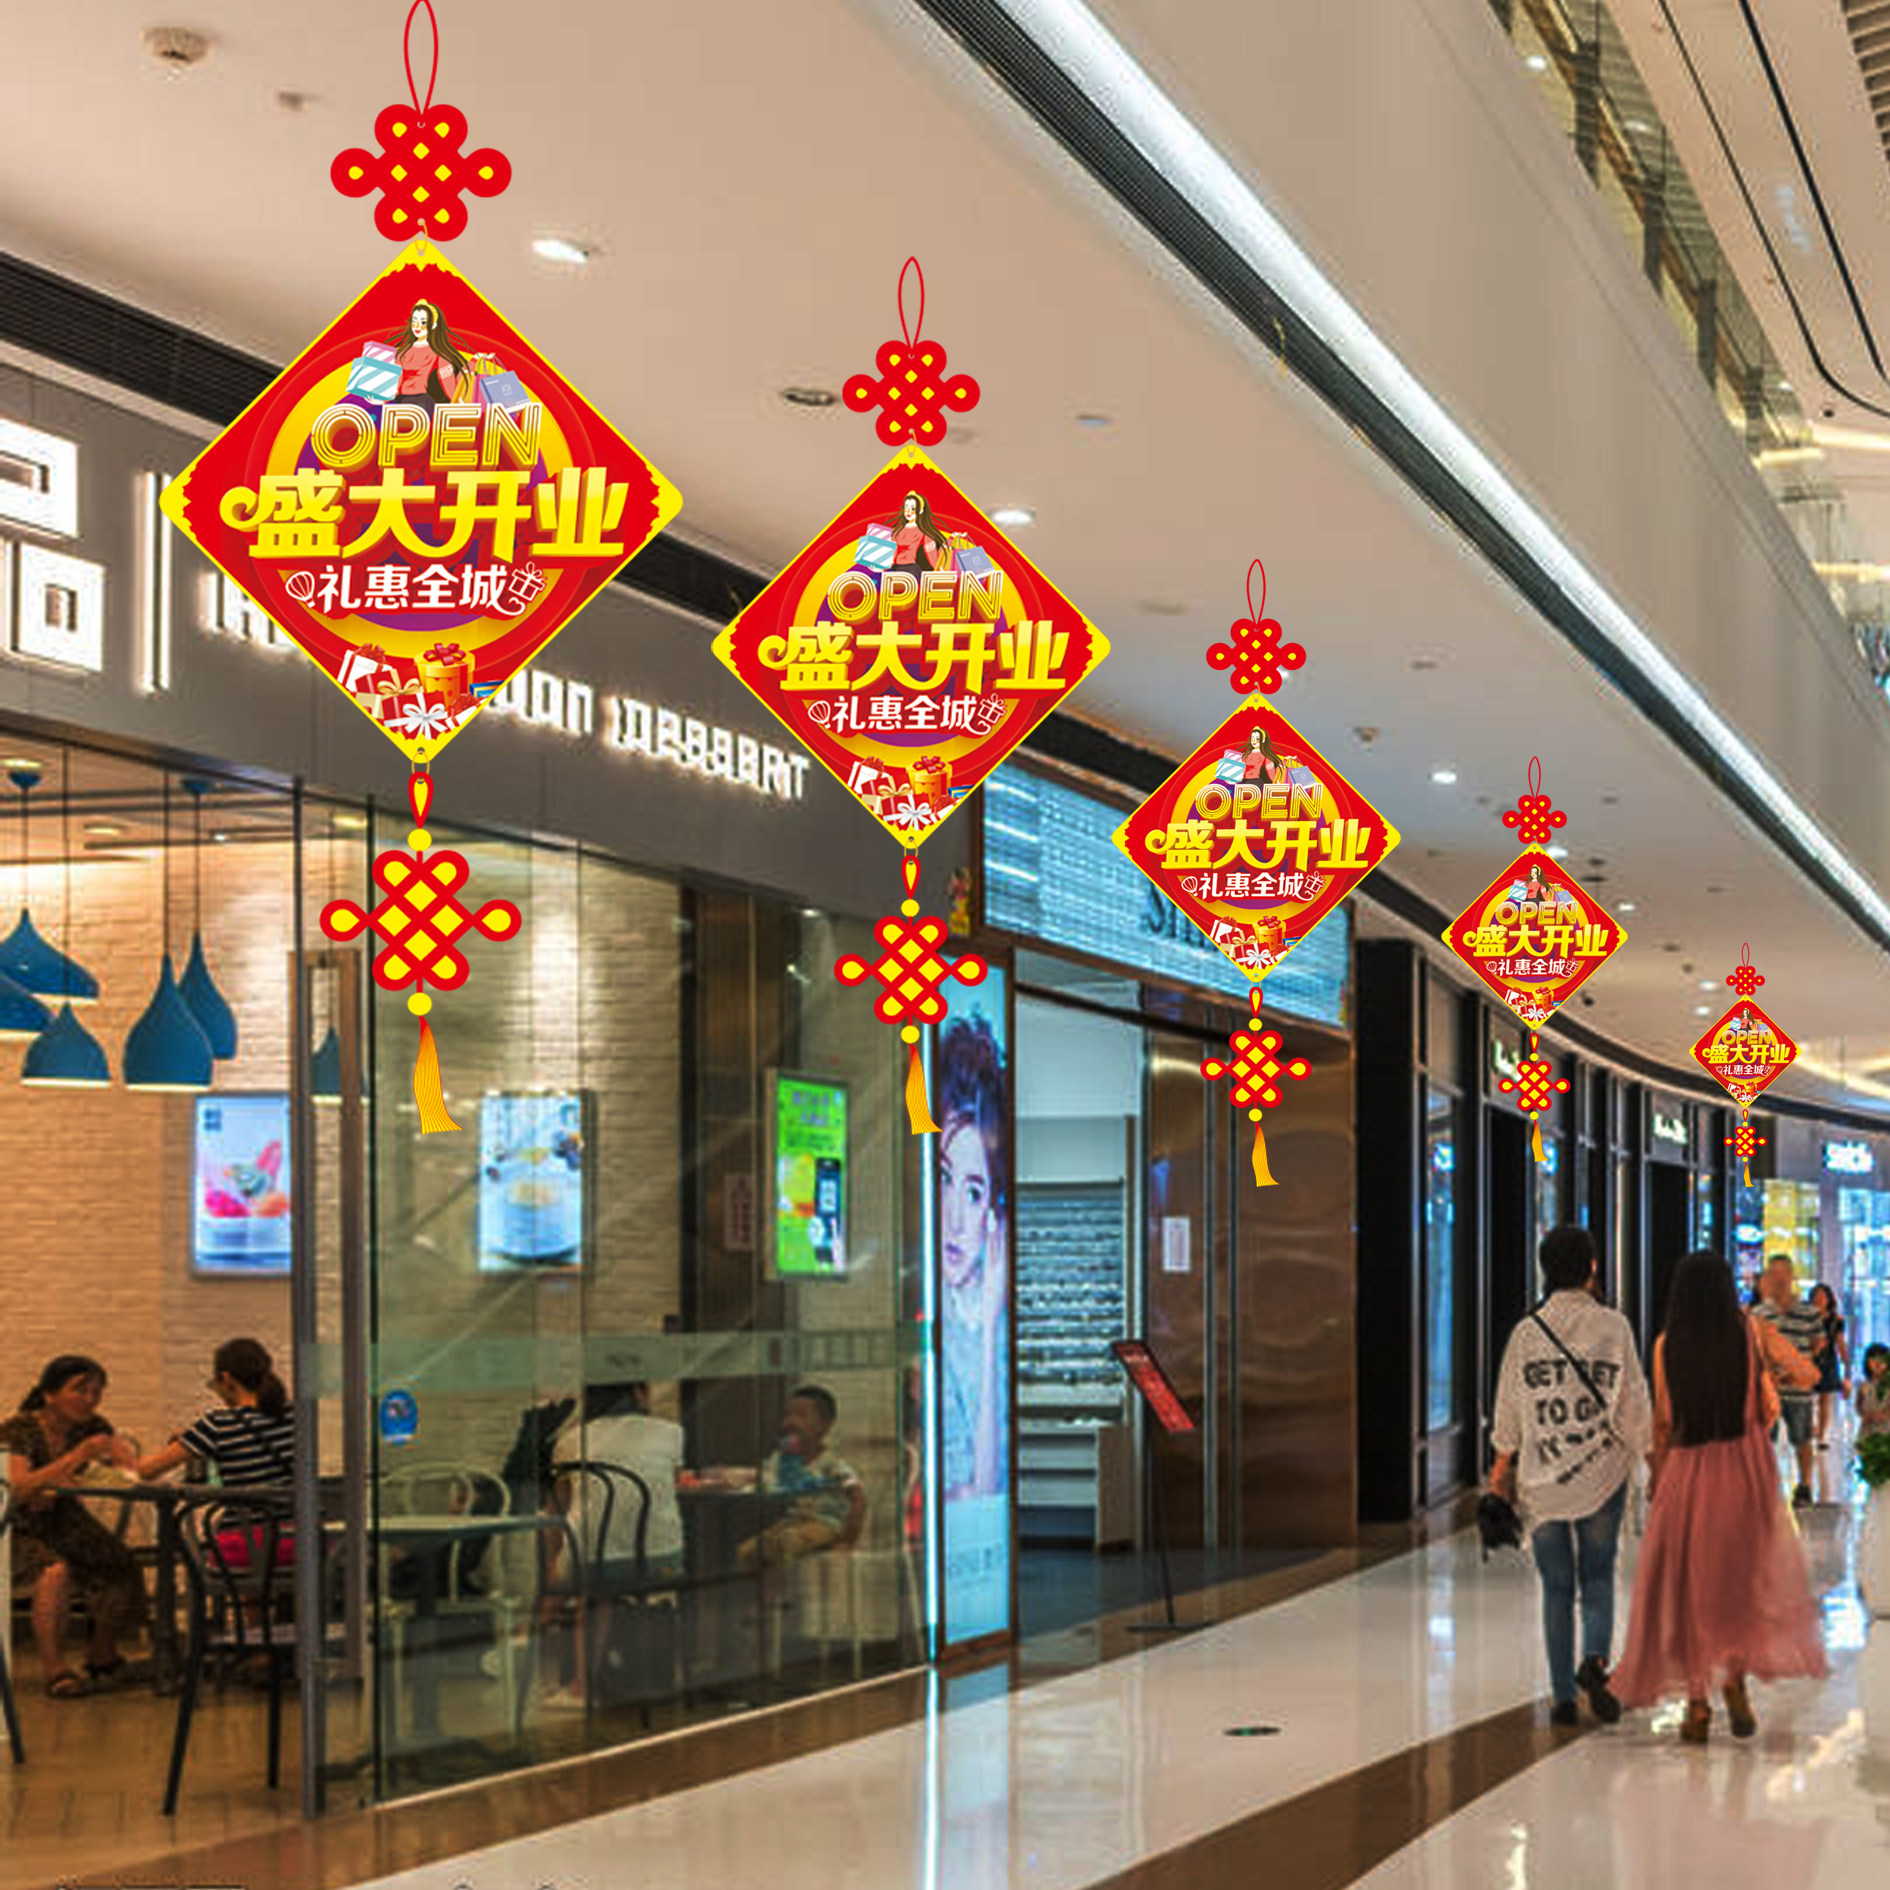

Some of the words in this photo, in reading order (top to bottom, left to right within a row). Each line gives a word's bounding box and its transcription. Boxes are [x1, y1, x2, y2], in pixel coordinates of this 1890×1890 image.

[311, 403, 542, 470] OPEN
[220, 467, 629, 564] 盛大开业
[317, 563, 520, 616] 礼惠全城
[828, 571, 1003, 623] OPEN
[758, 620, 1070, 695] 盛大开业
[831, 695, 980, 734] 礼惠全城
[1196, 783, 1323, 821] OPEN
[1145, 819, 1371, 872] 盛大开业
[1199, 871, 1308, 900] 礼惠全城
[1495, 901, 1578, 925] OPEN
[1463, 924, 1609, 959] 盛大开业
[1497, 959, 1569, 977] 礼惠全城
[1702, 1044, 1790, 1065] 盛大开业
[1722, 1030, 1771, 1045] OPEN
